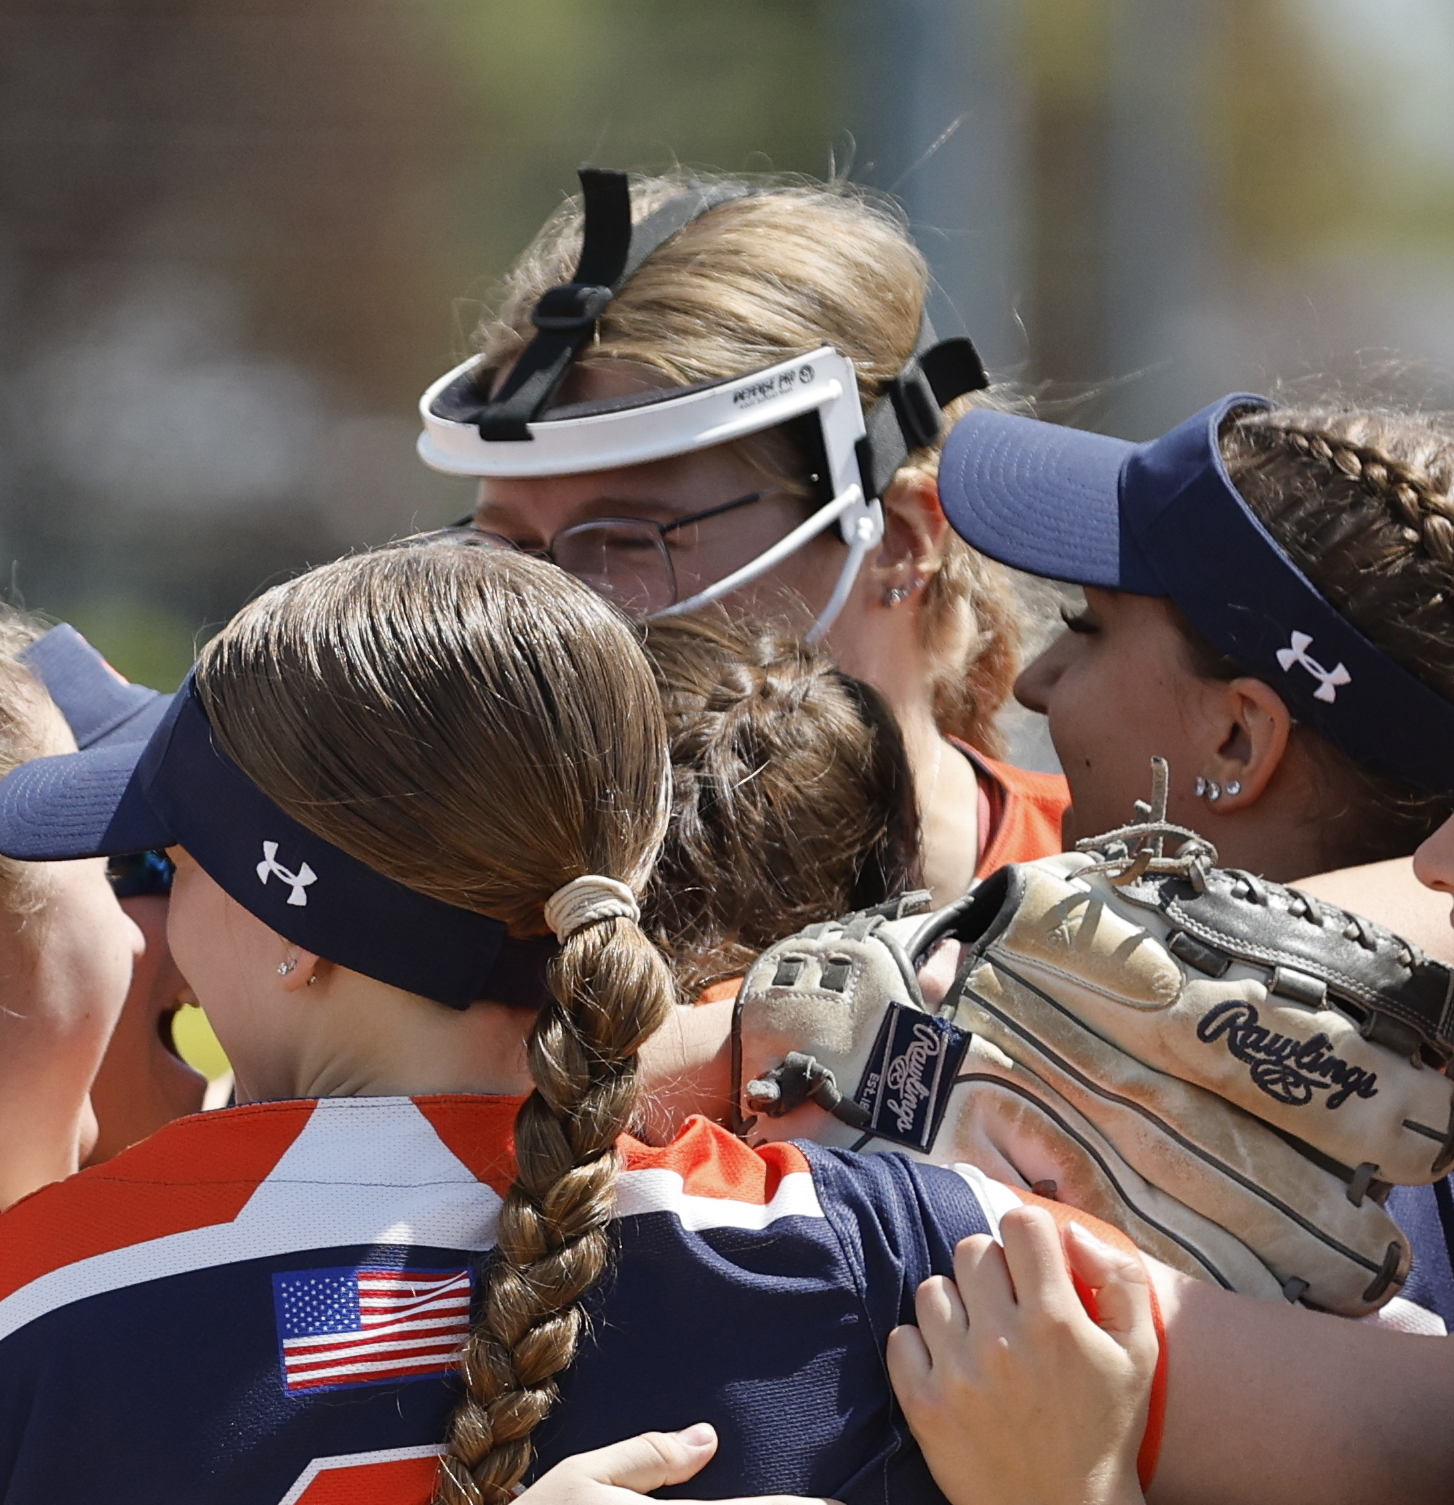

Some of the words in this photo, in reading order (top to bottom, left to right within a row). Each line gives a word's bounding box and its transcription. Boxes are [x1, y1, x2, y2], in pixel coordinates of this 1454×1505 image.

[862, 1072, 880, 1099] Est.
[887, 1023, 940, 1133] Rawlings
[1197, 1000, 1378, 1109] Rawlings
